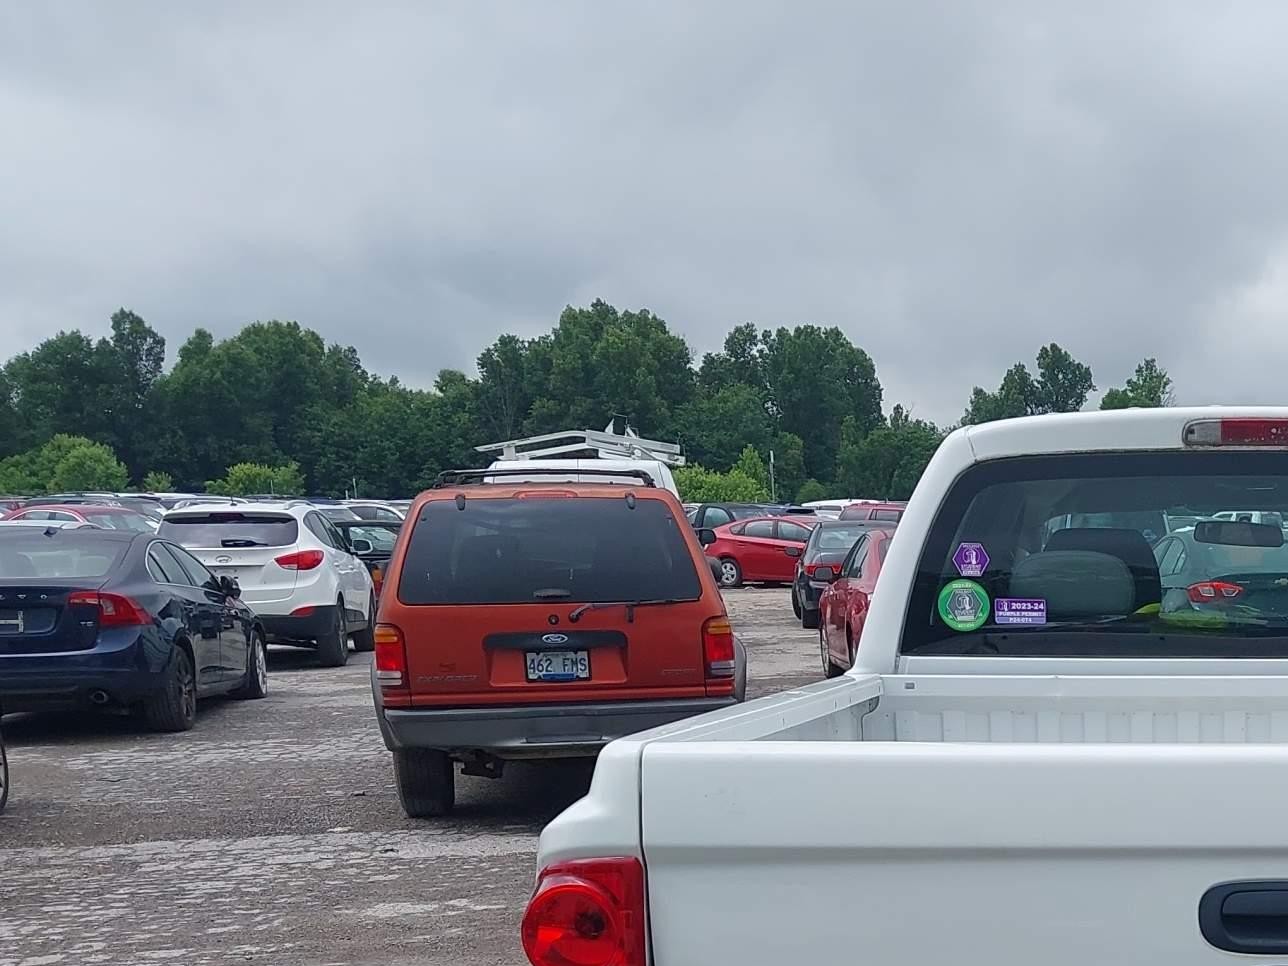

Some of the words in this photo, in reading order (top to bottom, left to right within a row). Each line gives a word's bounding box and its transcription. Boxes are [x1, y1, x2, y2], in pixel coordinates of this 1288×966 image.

[1011, 602, 1044, 610] 2023-24
[528, 658, 553, 673] 462
[562, 657, 587, 673] FMS
